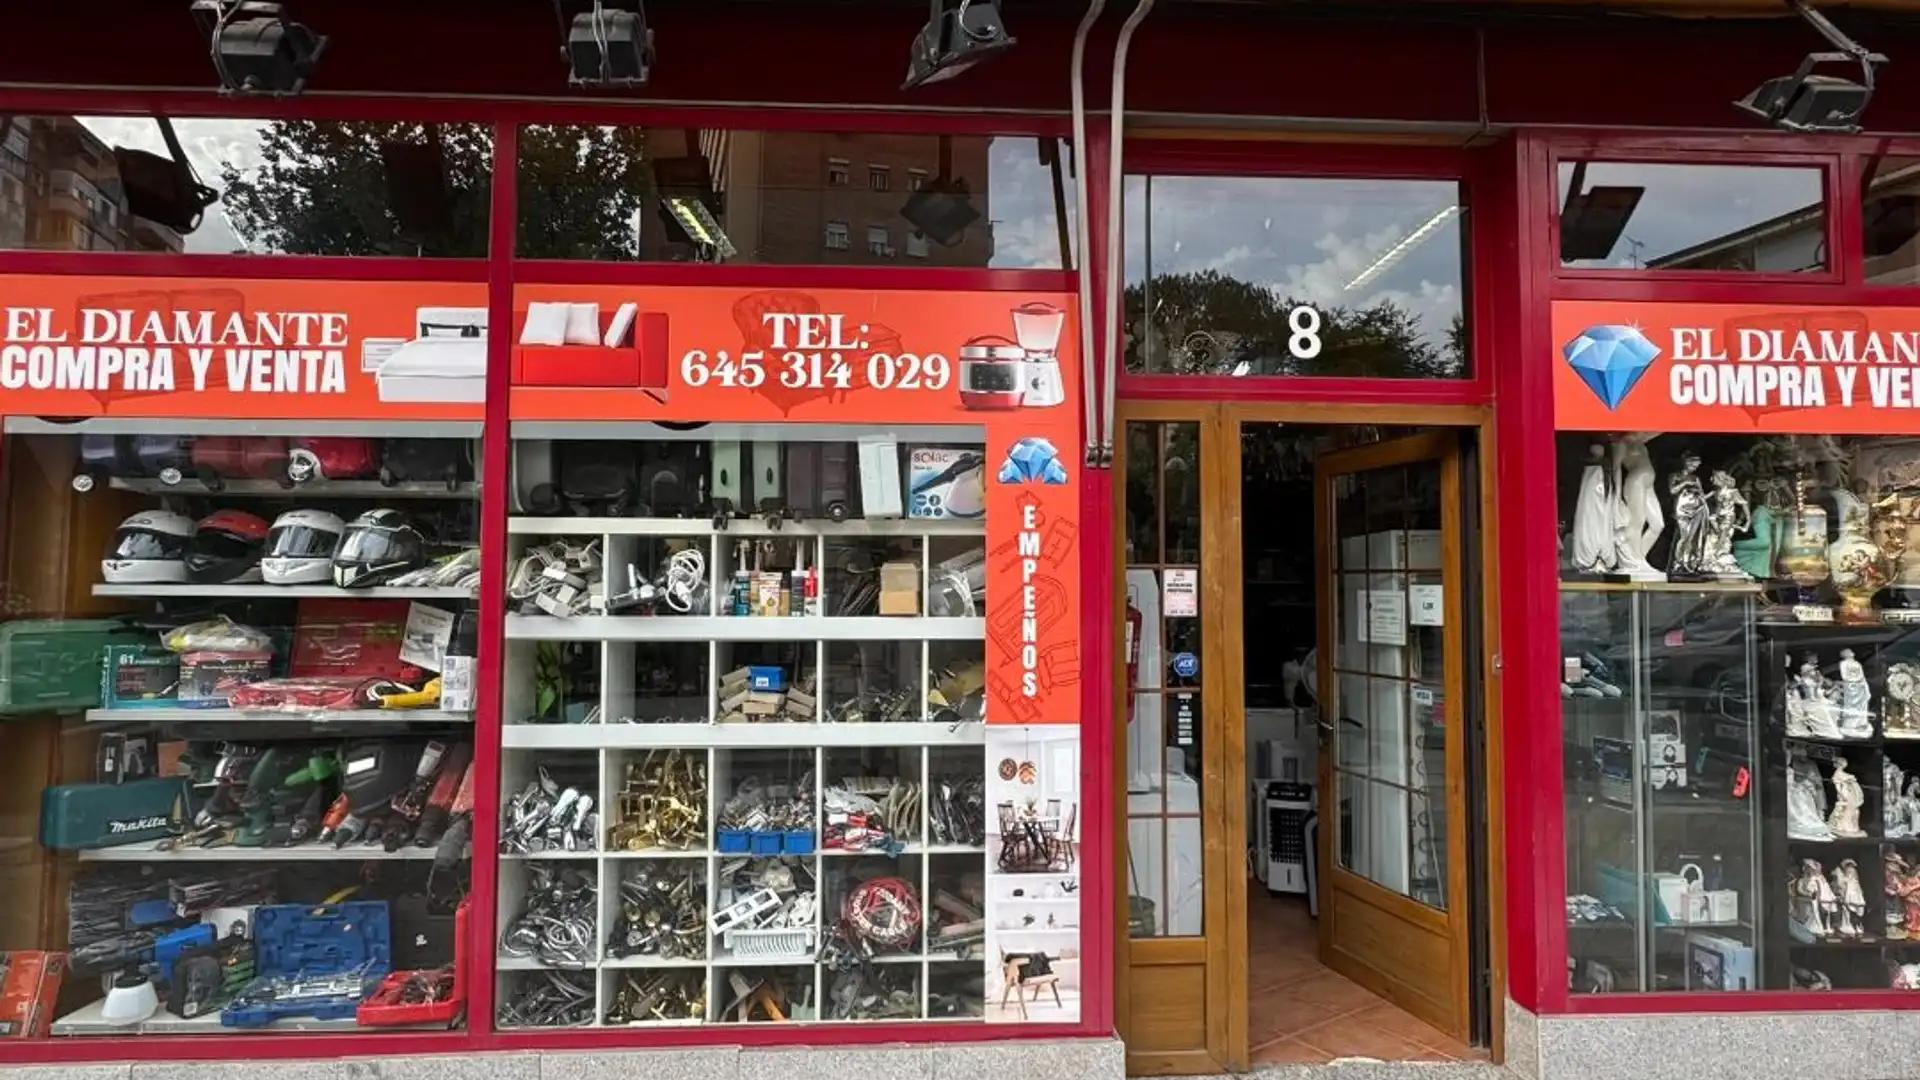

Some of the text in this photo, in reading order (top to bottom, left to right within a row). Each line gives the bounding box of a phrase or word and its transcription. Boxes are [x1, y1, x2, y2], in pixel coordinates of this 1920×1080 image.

[5, 307, 348, 346] EL DIAMANTE
[763, 312, 869, 350] TEL:
[1288, 305, 1323, 360] 8
[1670, 327, 1728, 361] EL
[1, 346, 346, 393] COMPRA Y VENTA
[680, 350, 951, 390] 645 314 029
[1669, 364, 1825, 407] COMPRA
[1834, 366, 1857, 407] Y
